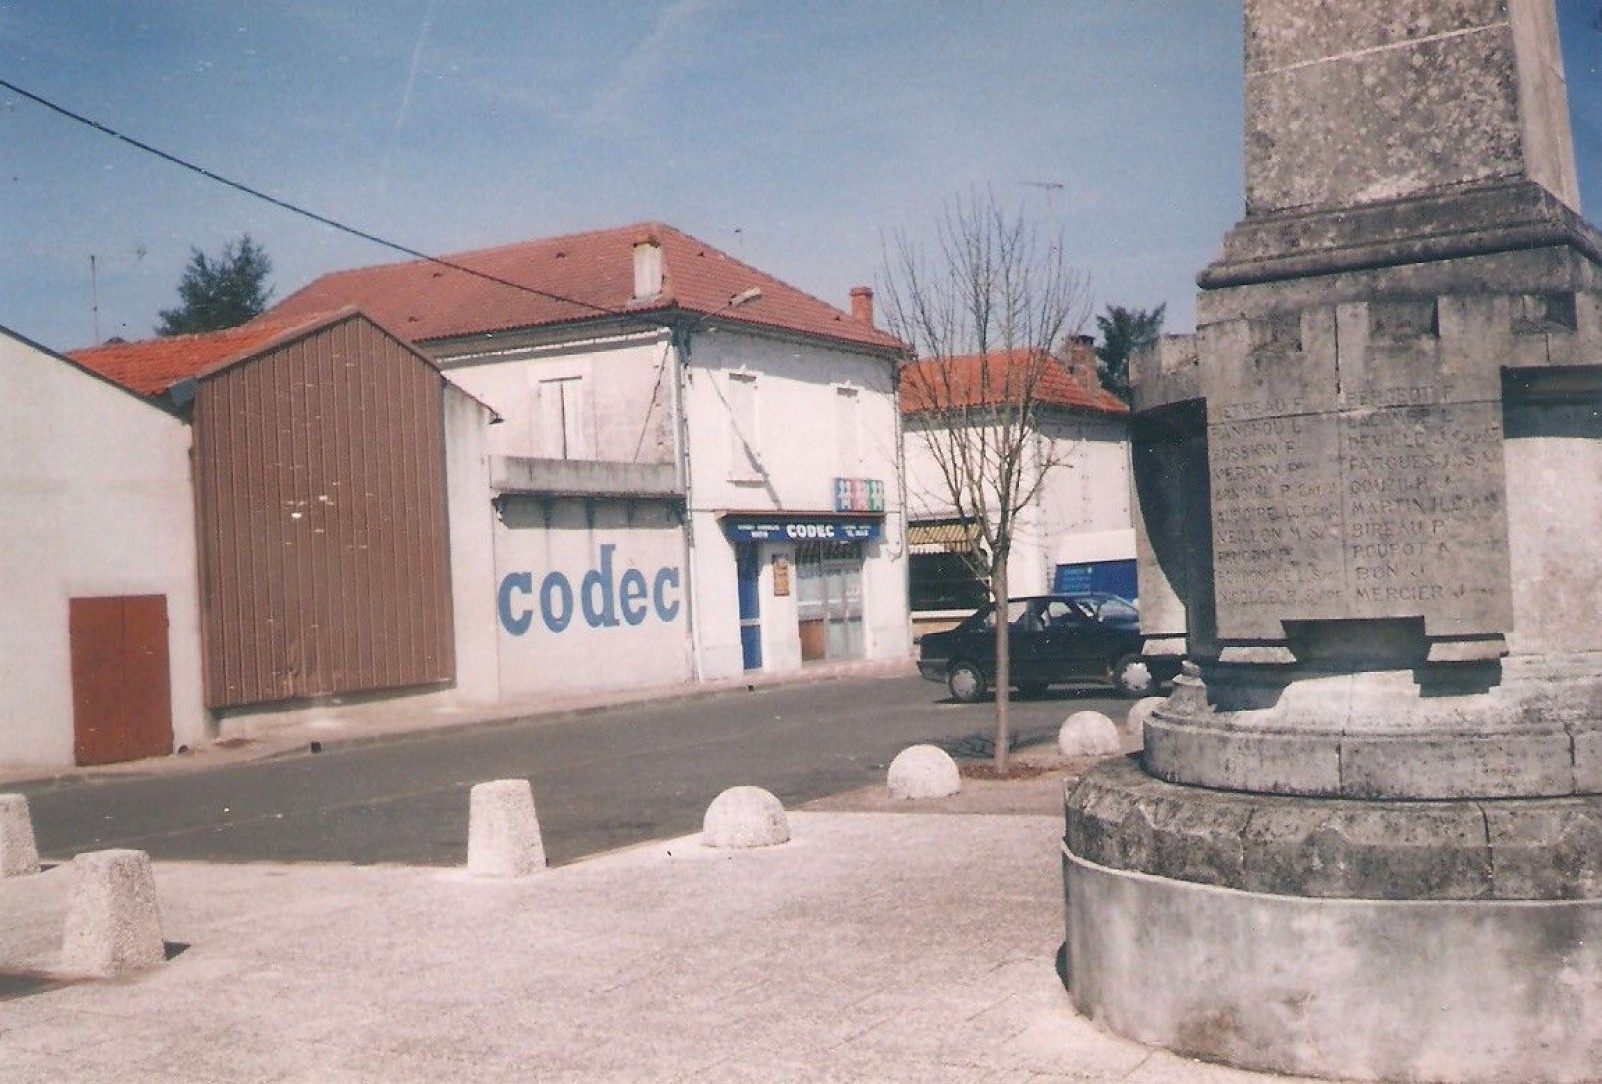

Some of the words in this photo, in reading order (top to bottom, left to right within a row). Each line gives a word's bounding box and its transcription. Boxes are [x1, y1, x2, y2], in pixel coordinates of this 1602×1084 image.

[786, 523, 835, 538] CODEC
[498, 543, 680, 636] codec
[1355, 584, 1444, 602] MERCIER
